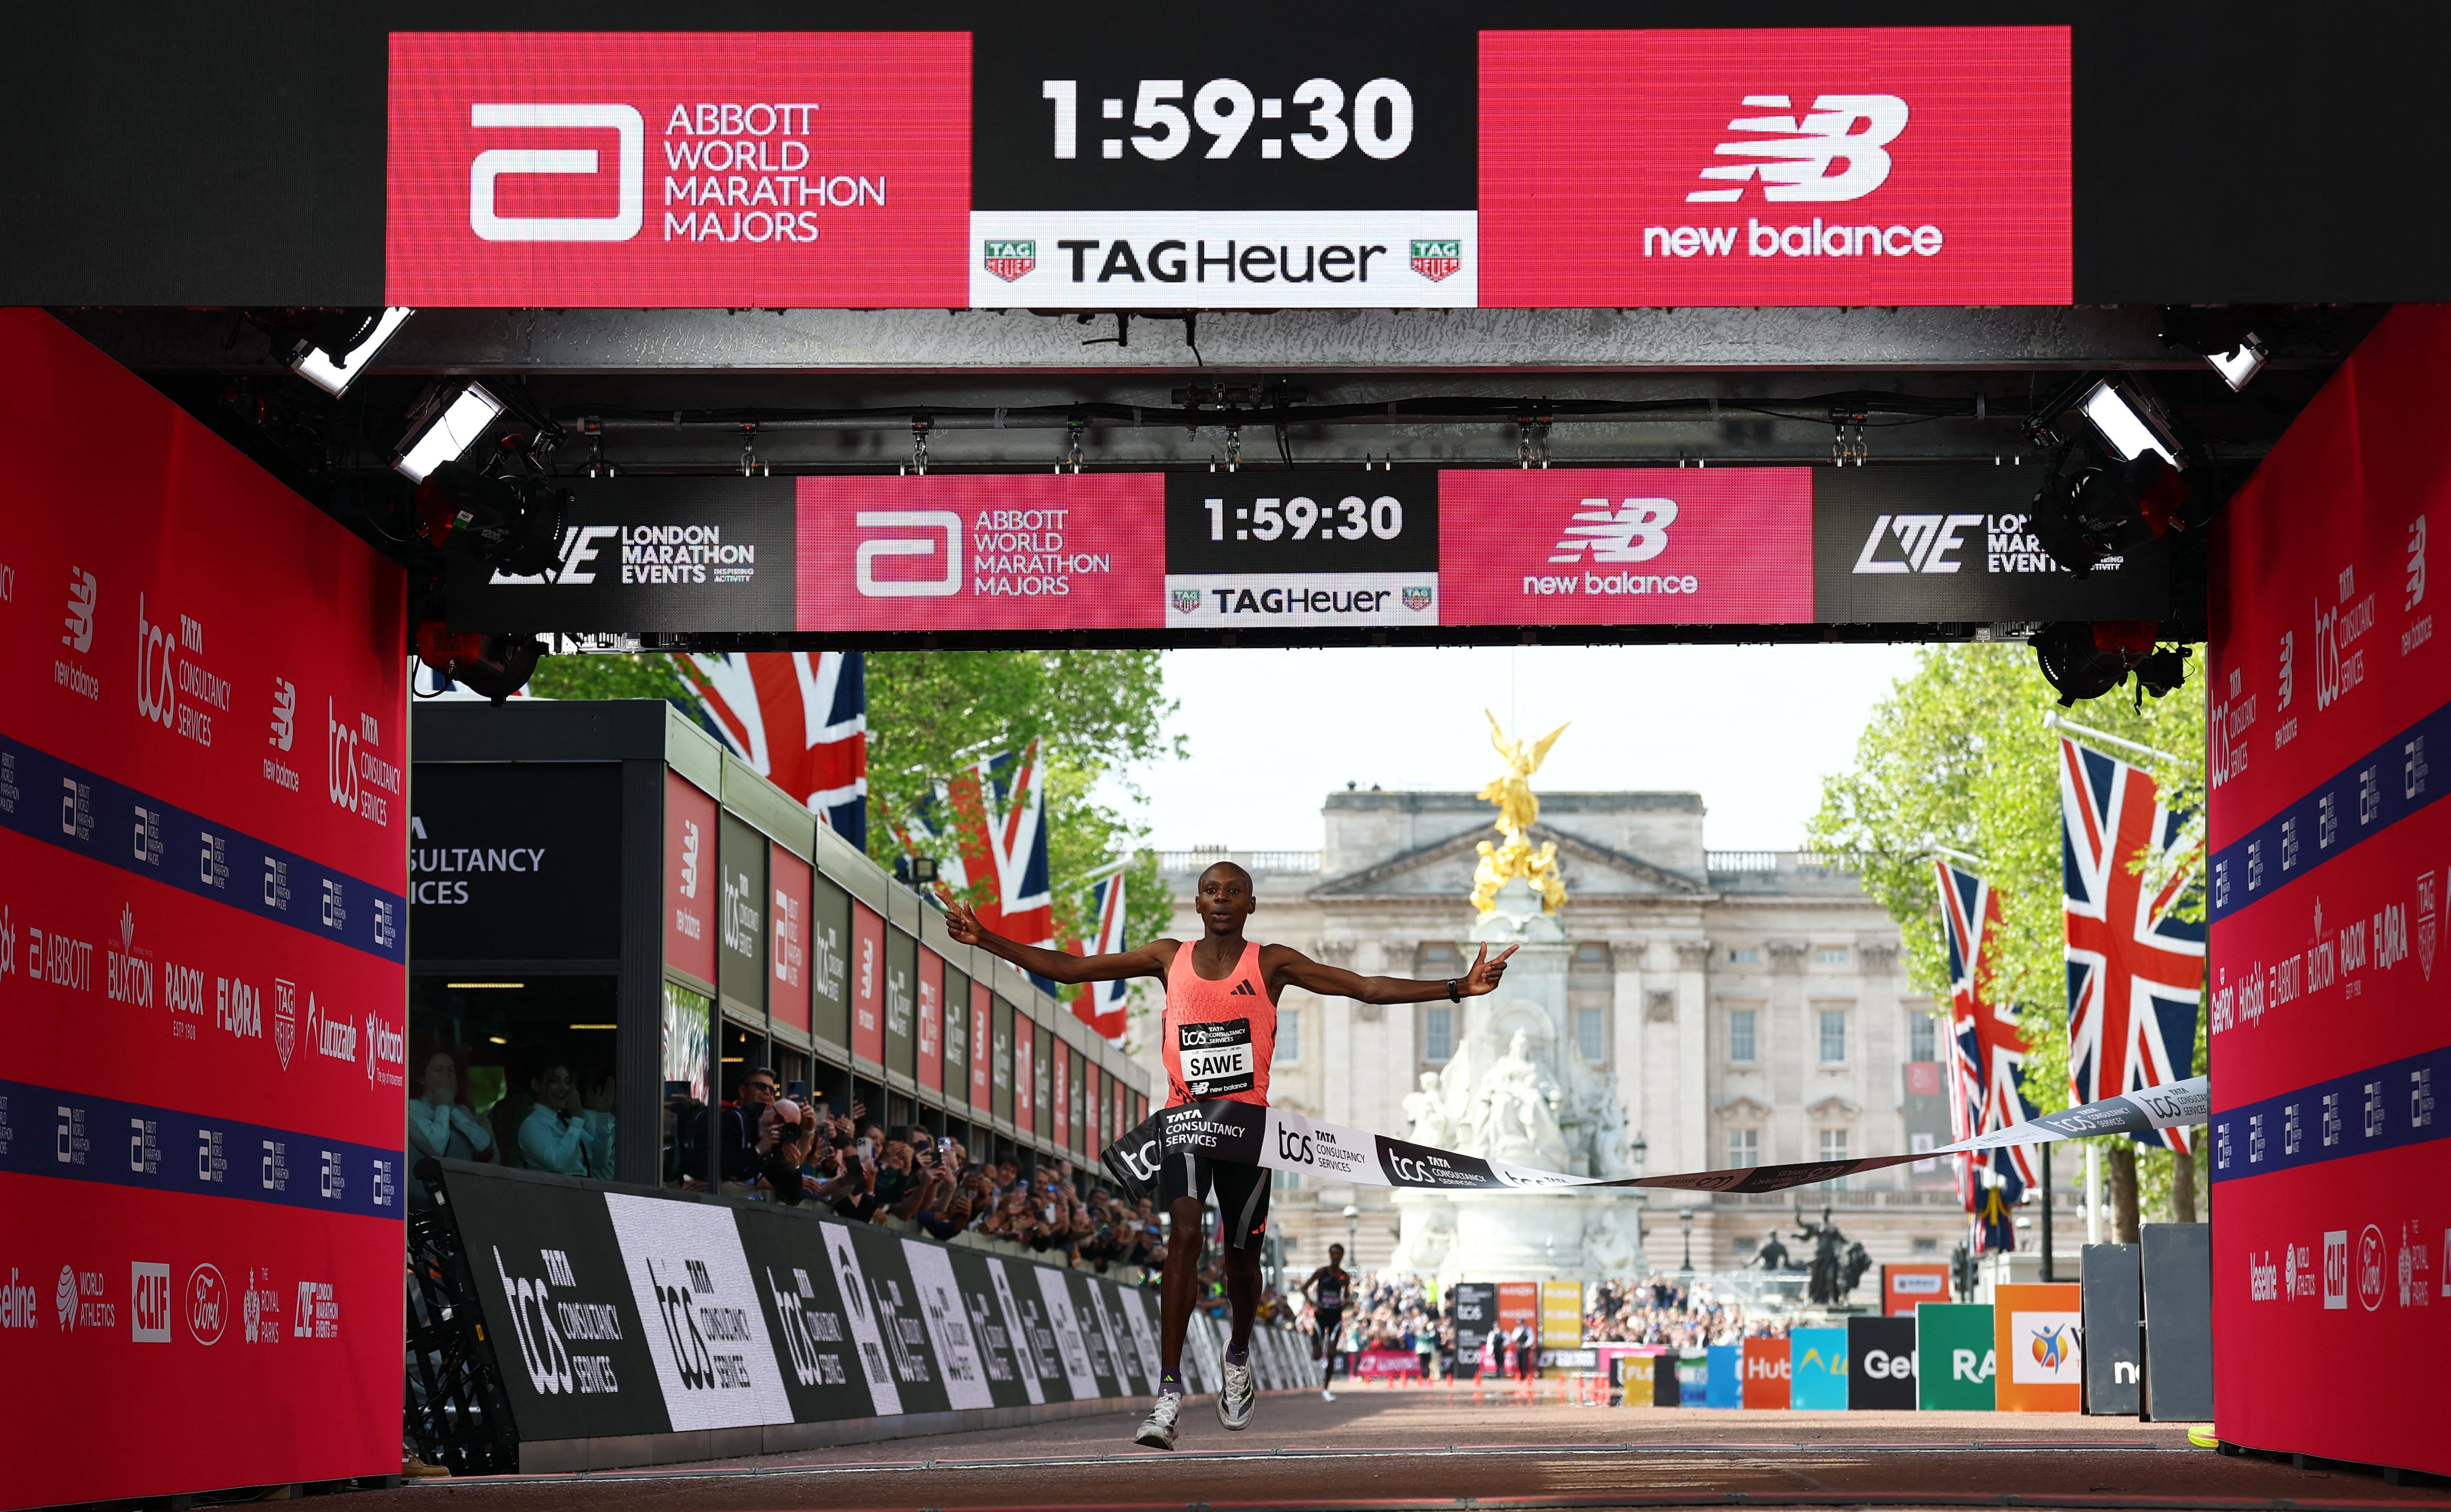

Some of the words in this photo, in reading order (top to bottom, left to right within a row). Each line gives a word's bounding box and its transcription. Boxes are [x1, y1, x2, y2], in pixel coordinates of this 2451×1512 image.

[665, 103, 820, 135] ABBOTT
[1042, 77, 1414, 160] 1:59:30
[664, 141, 809, 171] WORLD
[664, 176, 886, 205] MARATHON
[664, 211, 819, 243] MAJORS
[1644, 224, 1737, 256] new
[1749, 218, 1943, 257] balance
[989, 243, 1032, 255] TAG
[1415, 243, 1458, 255] TAG
[623, 526, 719, 544] LONDON
[975, 510, 1068, 530] ABBOTT
[1205, 496, 1402, 541] 1:59:30
[623, 545, 753, 563] MARATHON
[975, 533, 1063, 552] WORLD
[623, 565, 706, 584] EVENTS
[975, 554, 1110, 573] MARATHON
[1989, 553, 2076, 572] EVENT
[975, 576, 1069, 595] MAJORS
[1524, 574, 1578, 594] new
[1585, 571, 1698, 594] balance
[2339, 564, 2354, 604] TATA
[181, 614, 202, 655] TATA
[2340, 592, 2376, 649] CONSULTANCY
[138, 591, 175, 728] tcs
[2315, 596, 2339, 712] tcs
[55, 659, 70, 686] new
[71, 660, 98, 701] balance
[179, 659, 231, 712] CONSULTANCY
[2230, 667, 2241, 700] TATA
[2341, 648, 2364, 695] SERVICES
[178, 703, 211, 747] SERVICES
[361, 712, 378, 746] TATA
[2231, 693, 2256, 740] CONSULTANCY
[2283, 716, 2297, 747] balance
[329, 695, 357, 813] tcs
[2212, 689, 2228, 790] tcs
[263, 758, 275, 780] new
[276, 758, 299, 792] balance
[361, 751, 400, 795] CONSULTANCY
[2231, 741, 2248, 779] SERVICES
[361, 790, 387, 827] SERVICES
[2419, 879, 2433, 914] TAG
[2340, 919, 2366, 978] RADOX
[2374, 902, 2408, 970] FLORA
[45, 933, 93, 991] ABBOTT
[2308, 940, 2335, 994] BUXTON
[108, 950, 152, 1009] BUXTON
[166, 962, 204, 1016] RADOX
[2239, 961, 2265, 1028] HubSpot
[2277, 954, 2301, 1006] ABBOTT
[217, 977, 262, 1039] FLORA
[277, 985, 293, 1015] TAG
[2212, 986, 2234, 1036] GetPRO
[276, 1020, 294, 1062] HEUER
[320, 1006, 355, 1063] Lucozade
[376, 1017, 403, 1064] Voltarol
[1182, 1029, 1206, 1046] tcs
[1209, 1029, 1245, 1038] CONSULTANCY
[1191, 1054, 1242, 1076] SAWE
[1224, 1083, 1247, 1091] balance
[1166, 1109, 1202, 1124] TATA
[2046, 1116, 2096, 1133] tcs
[2088, 1107, 2131, 1120] CONSULTANCY
[2097, 1117, 2126, 1128] SERVICES
[2139, 1096, 2182, 1119] tcs
[1166, 1121, 1245, 1138] CONSULTANCY
[1166, 1134, 1217, 1147] SERVICES
[1278, 1121, 1314, 1165] tcs
[1316, 1130, 1336, 1144] TATA
[1120, 1140, 1161, 1181] tc
[1317, 1144, 1365, 1164] CONSULTANCY
[1318, 1158, 1351, 1173] SERVICES
[1389, 1148, 1436, 1183] tcs
[1427, 1156, 1451, 1169] TATA
[1432, 1168, 1487, 1183] CONSULTANCY
[540, 1250, 576, 1288] TATA
[685, 1260, 714, 1294] TATA
[2250, 1250, 2277, 1301] Vaseline
[2326, 1244, 2345, 1296] CLIF
[2362, 1237, 2381, 1294] Ford
[80, 1272, 103, 1296] WORLD
[262, 1290, 279, 1312] ROYAL
[316, 1283, 333, 1301] LONDON
[80, 1303, 115, 1327] ATHLETICS
[136, 1274, 167, 1330] CLIF
[194, 1274, 220, 1331] Ford
[316, 1302, 338, 1320] MARATHON
[261, 1321, 278, 1343] PARKS
[316, 1320, 330, 1338] EVENTS
[493, 1245, 573, 1394] tcs
[557, 1303, 623, 1340] CONSULTANCY
[647, 1258, 714, 1390] tcs
[700, 1307, 752, 1341] CONSULTANCY
[573, 1356, 618, 1393] SERVICES
[713, 1355, 750, 1388] SERVICES
